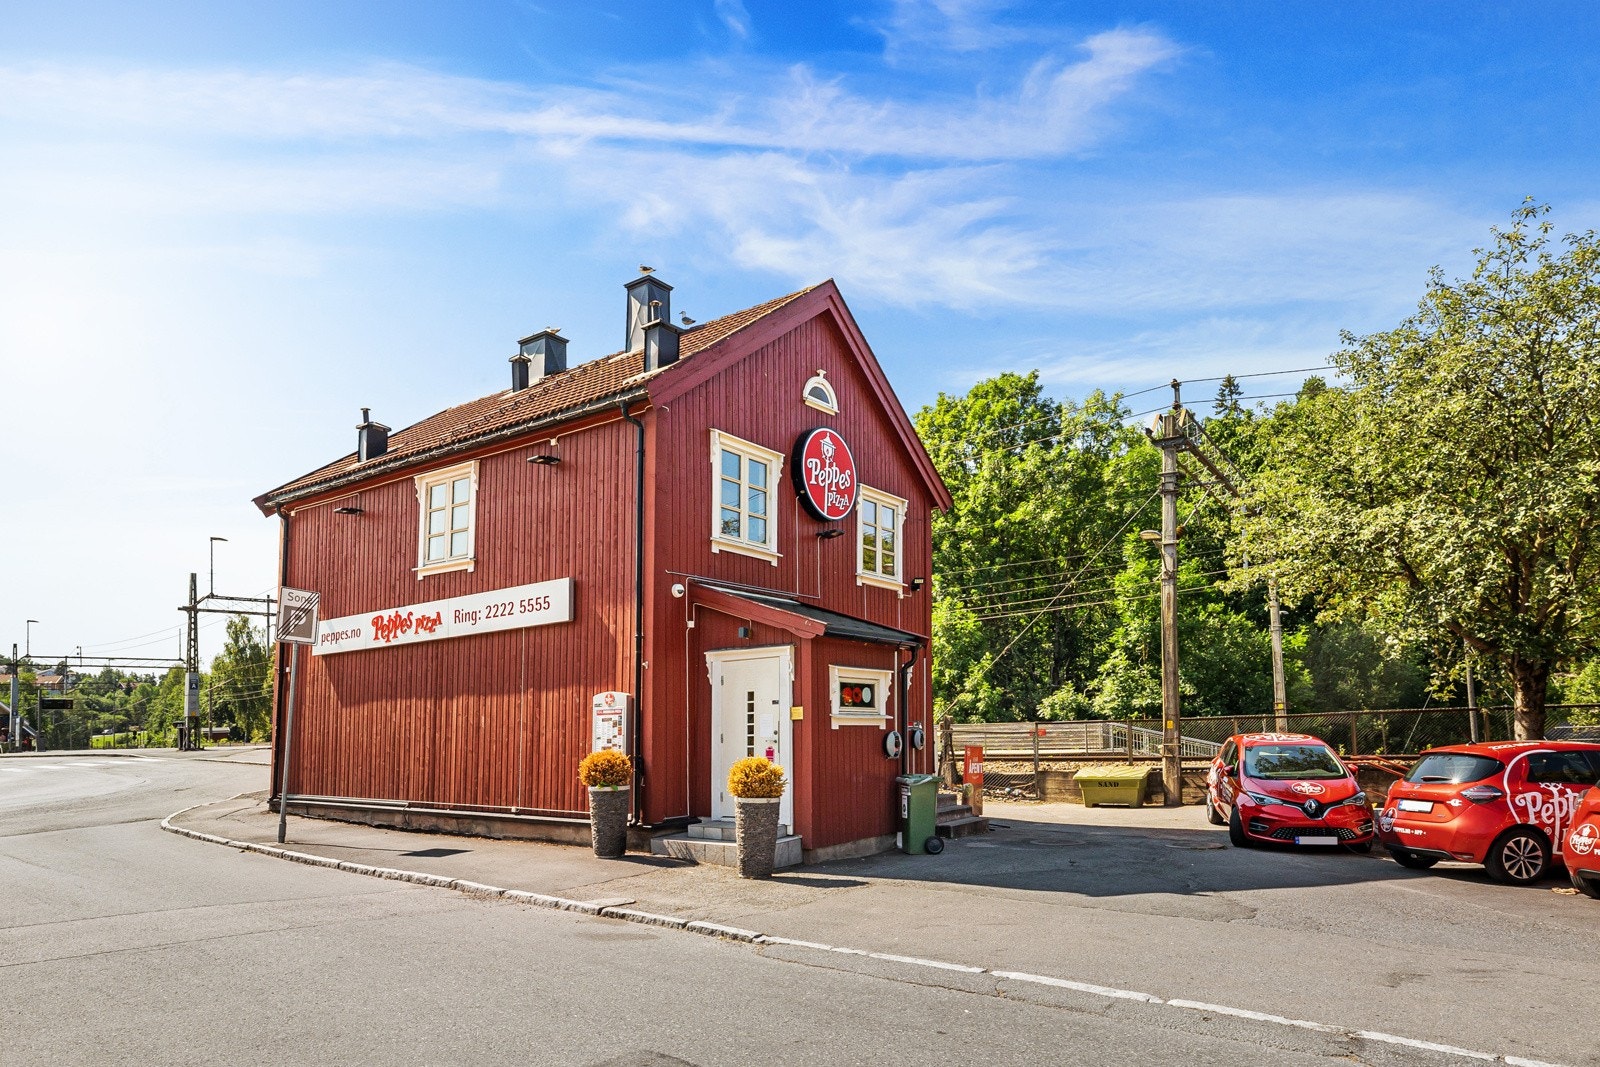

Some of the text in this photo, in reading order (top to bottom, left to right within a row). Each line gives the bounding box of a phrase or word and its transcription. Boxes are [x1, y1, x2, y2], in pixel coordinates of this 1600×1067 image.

[807, 458, 851, 491] Peppes
[321, 627, 361, 646] peppes.no
[371, 610, 413, 643] Peppes
[454, 608, 482, 626] Ring:
[485, 601, 514, 620] 2222
[519, 595, 551, 614] 5555
